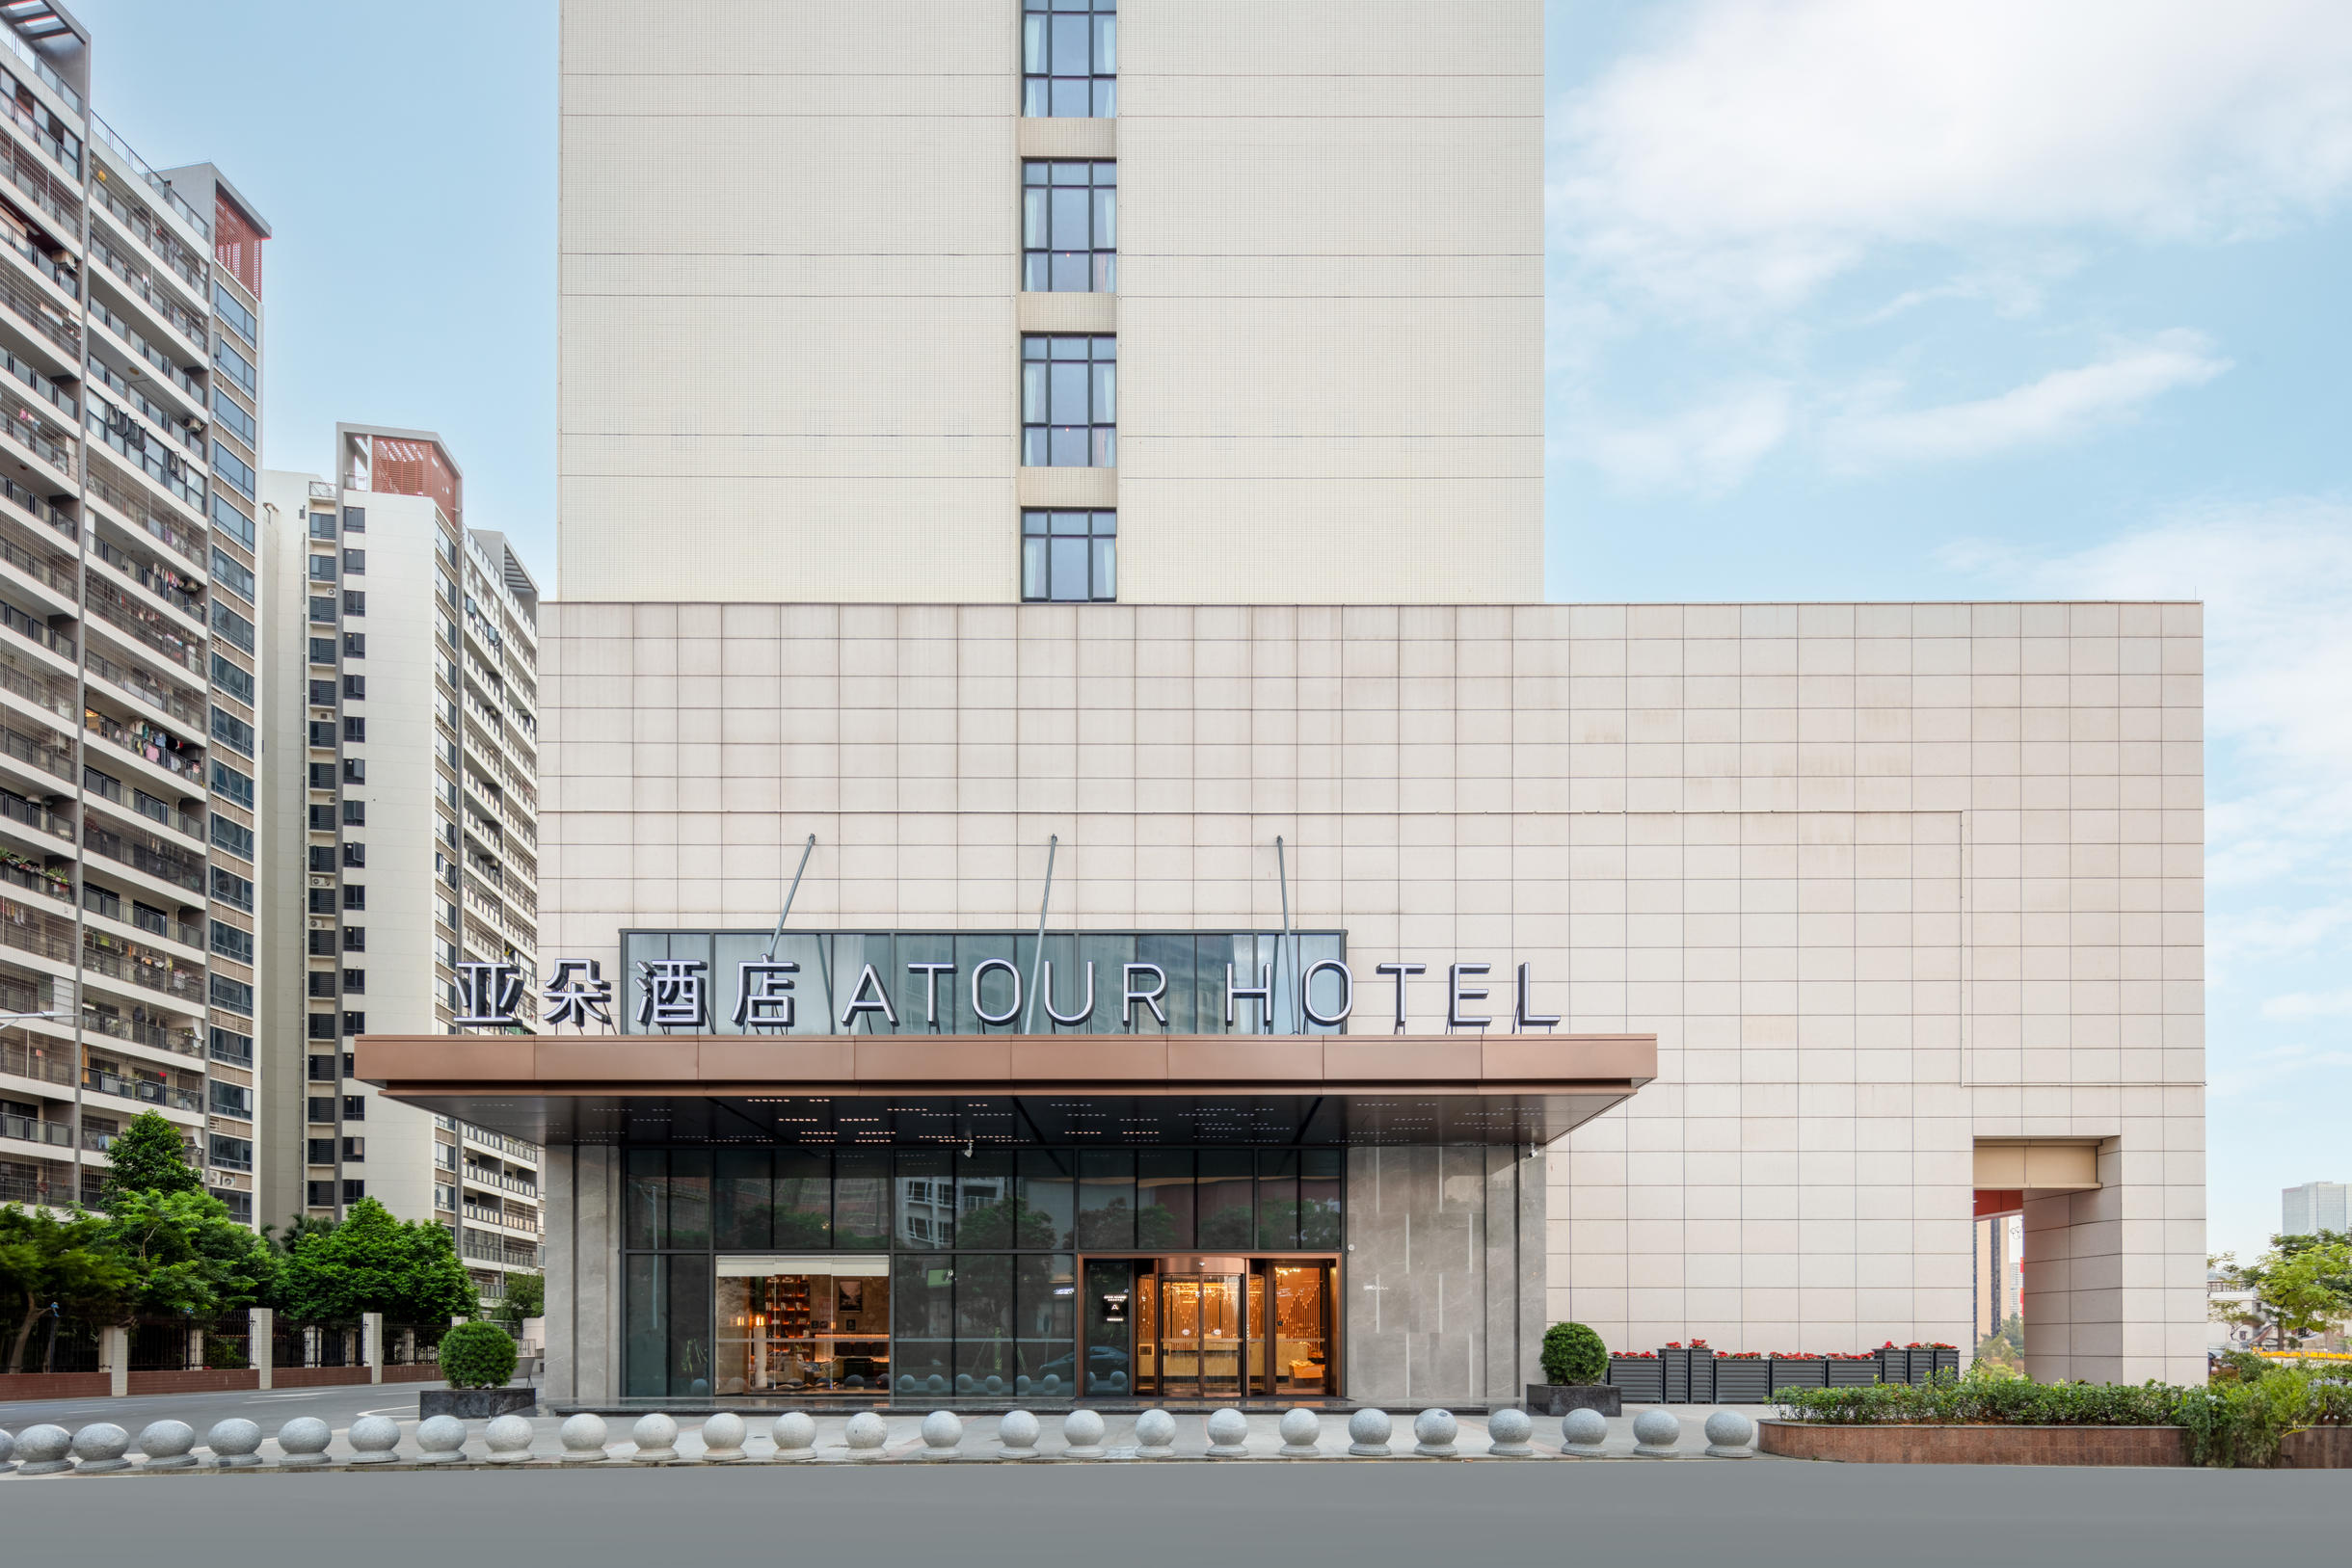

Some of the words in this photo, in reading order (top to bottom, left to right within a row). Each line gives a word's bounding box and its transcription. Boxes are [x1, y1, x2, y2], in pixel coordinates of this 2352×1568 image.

[452, 954, 800, 1027] 亚朵酒店
[841, 959, 1169, 1027] ATOUR
[1224, 959, 1561, 1026] HOTEL
